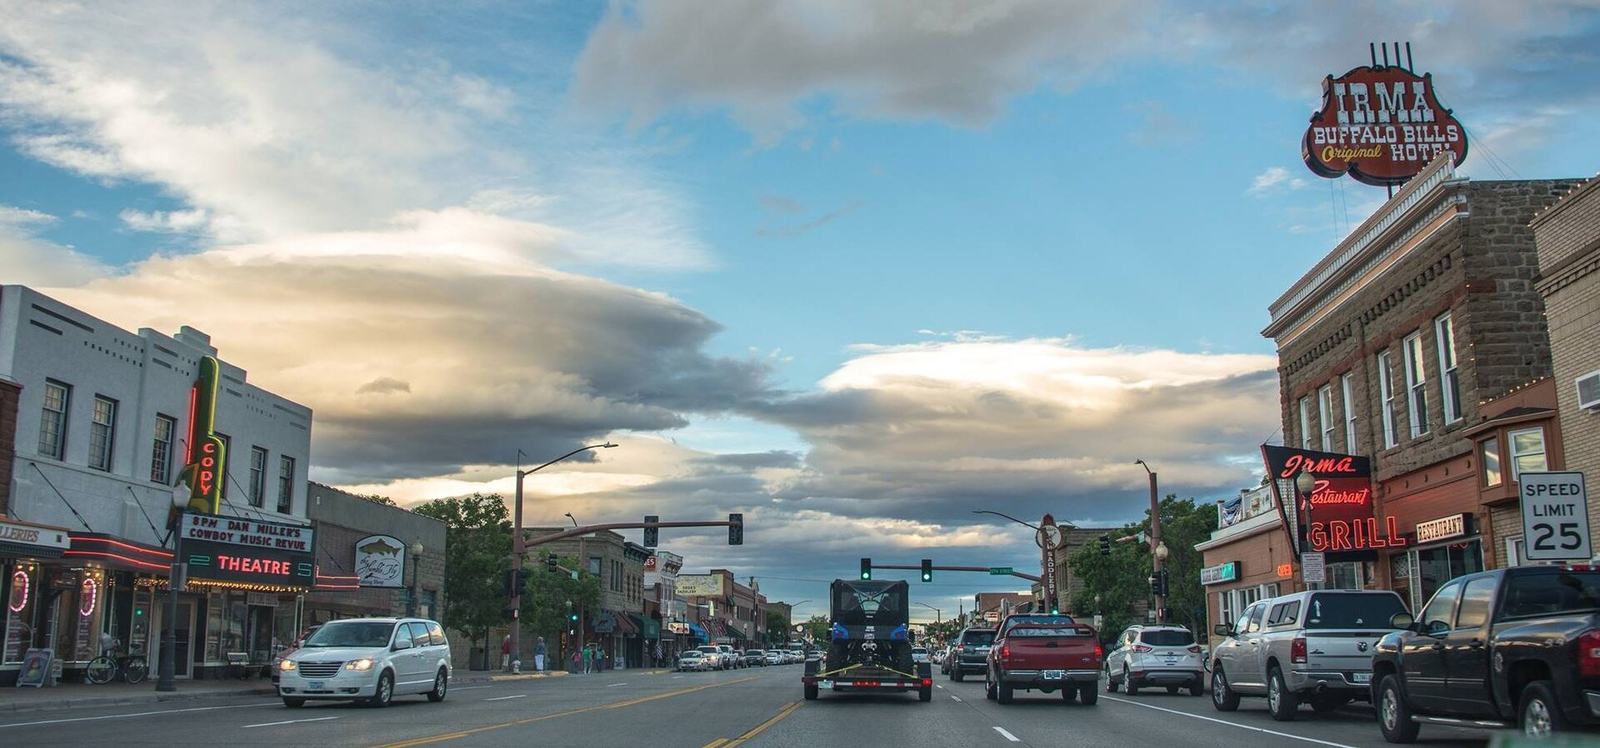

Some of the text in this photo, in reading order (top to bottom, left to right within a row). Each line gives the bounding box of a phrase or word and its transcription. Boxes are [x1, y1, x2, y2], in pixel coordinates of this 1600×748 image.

[1334, 82, 1435, 123] IRMA
[1314, 125, 1459, 143] BUFFALO BILLS
[1322, 145, 1381, 162] Original
[202, 443, 214, 494] CODY
[1281, 455, 1356, 478] Irma
[1526, 484, 1580, 496] SPEED
[1533, 504, 1575, 516] LIMIT
[189, 528, 306, 551] COWBOY MUSIC REVUE
[228, 521, 250, 532] DAN
[257, 525, 301, 539] MILLER'S
[1307, 516, 1405, 552] GRILL
[1418, 517, 1461, 541] RESTAURANT
[1532, 523, 1581, 549] 25
[218, 555, 290, 575] THEATRE
[1047, 551, 1055, 594] SADDLERY
